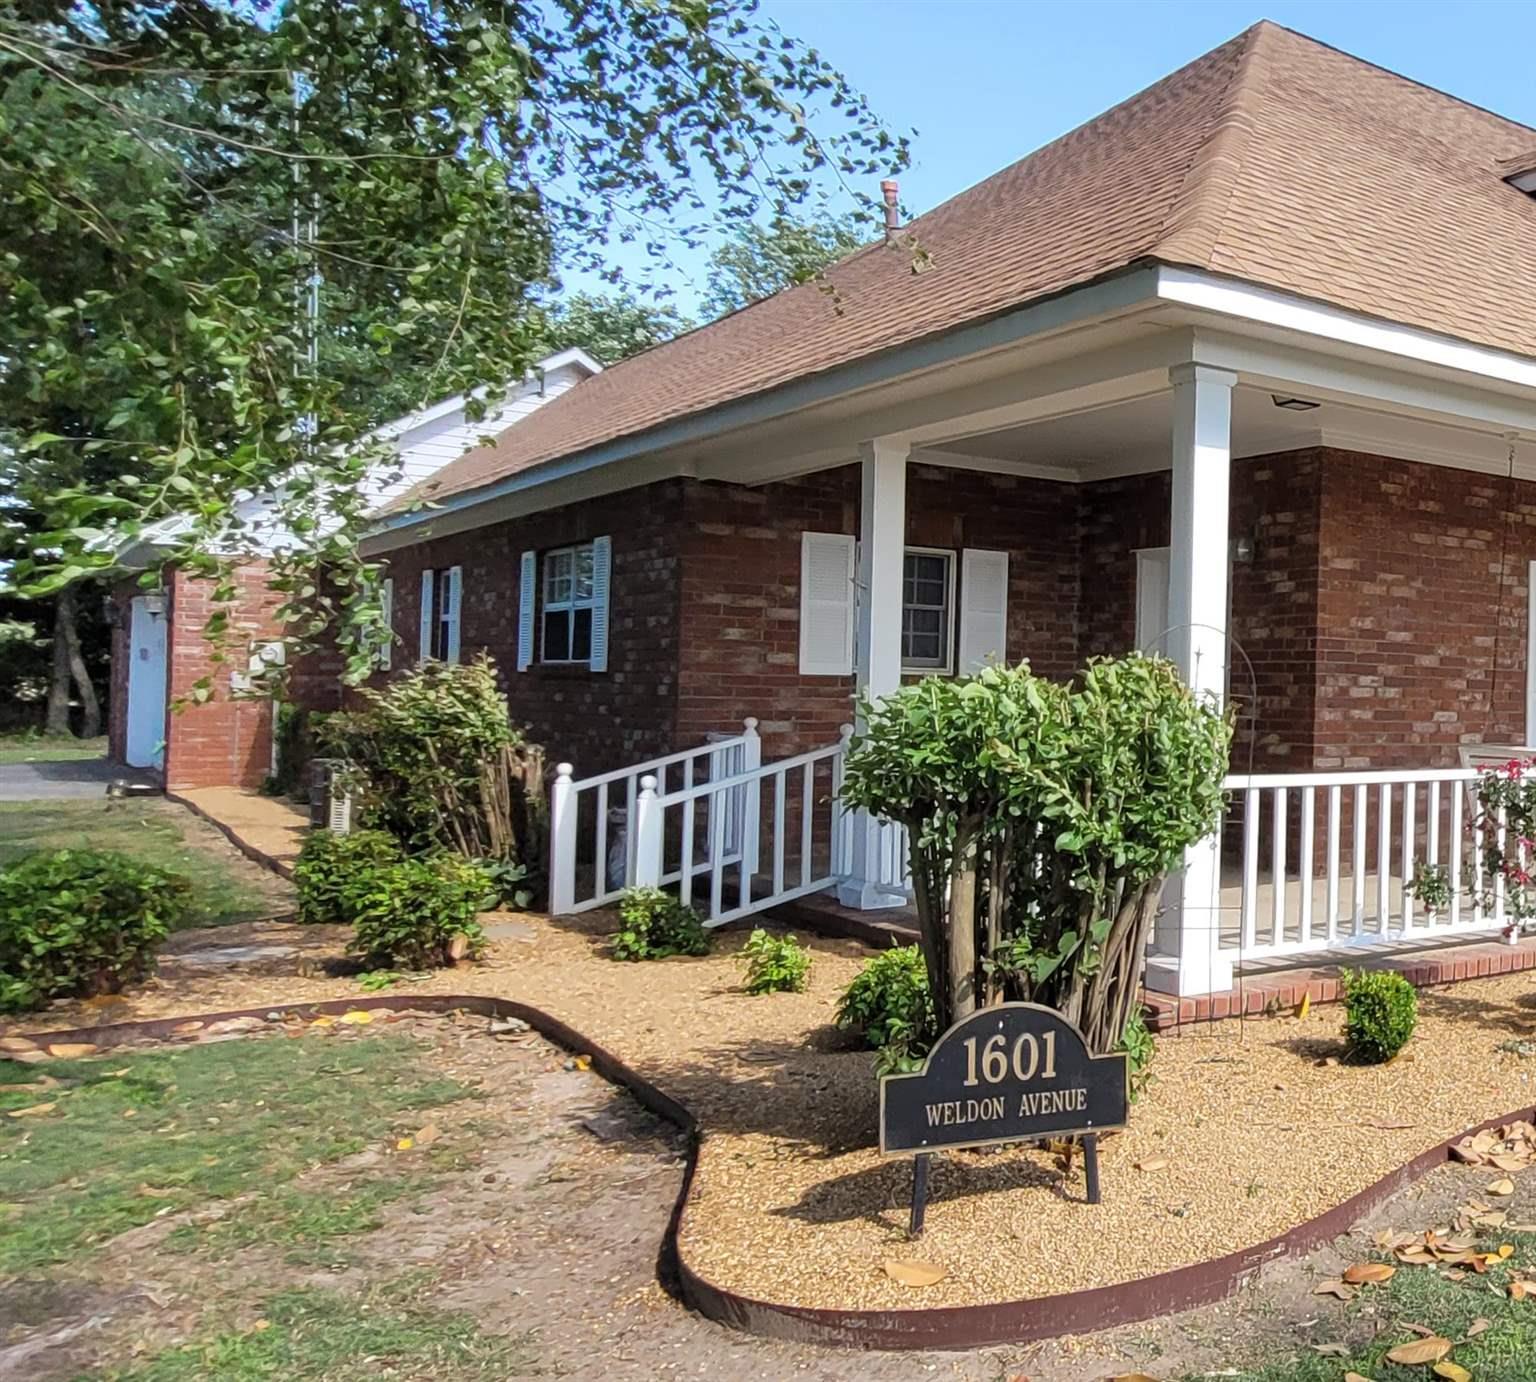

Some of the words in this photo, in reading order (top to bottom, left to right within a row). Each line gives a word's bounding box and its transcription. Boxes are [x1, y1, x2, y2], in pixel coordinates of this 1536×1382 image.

[963, 1031, 1056, 1086] 1601
[925, 1097, 1005, 1127] WELDON
[1018, 1088, 1088, 1117] AVENUE
